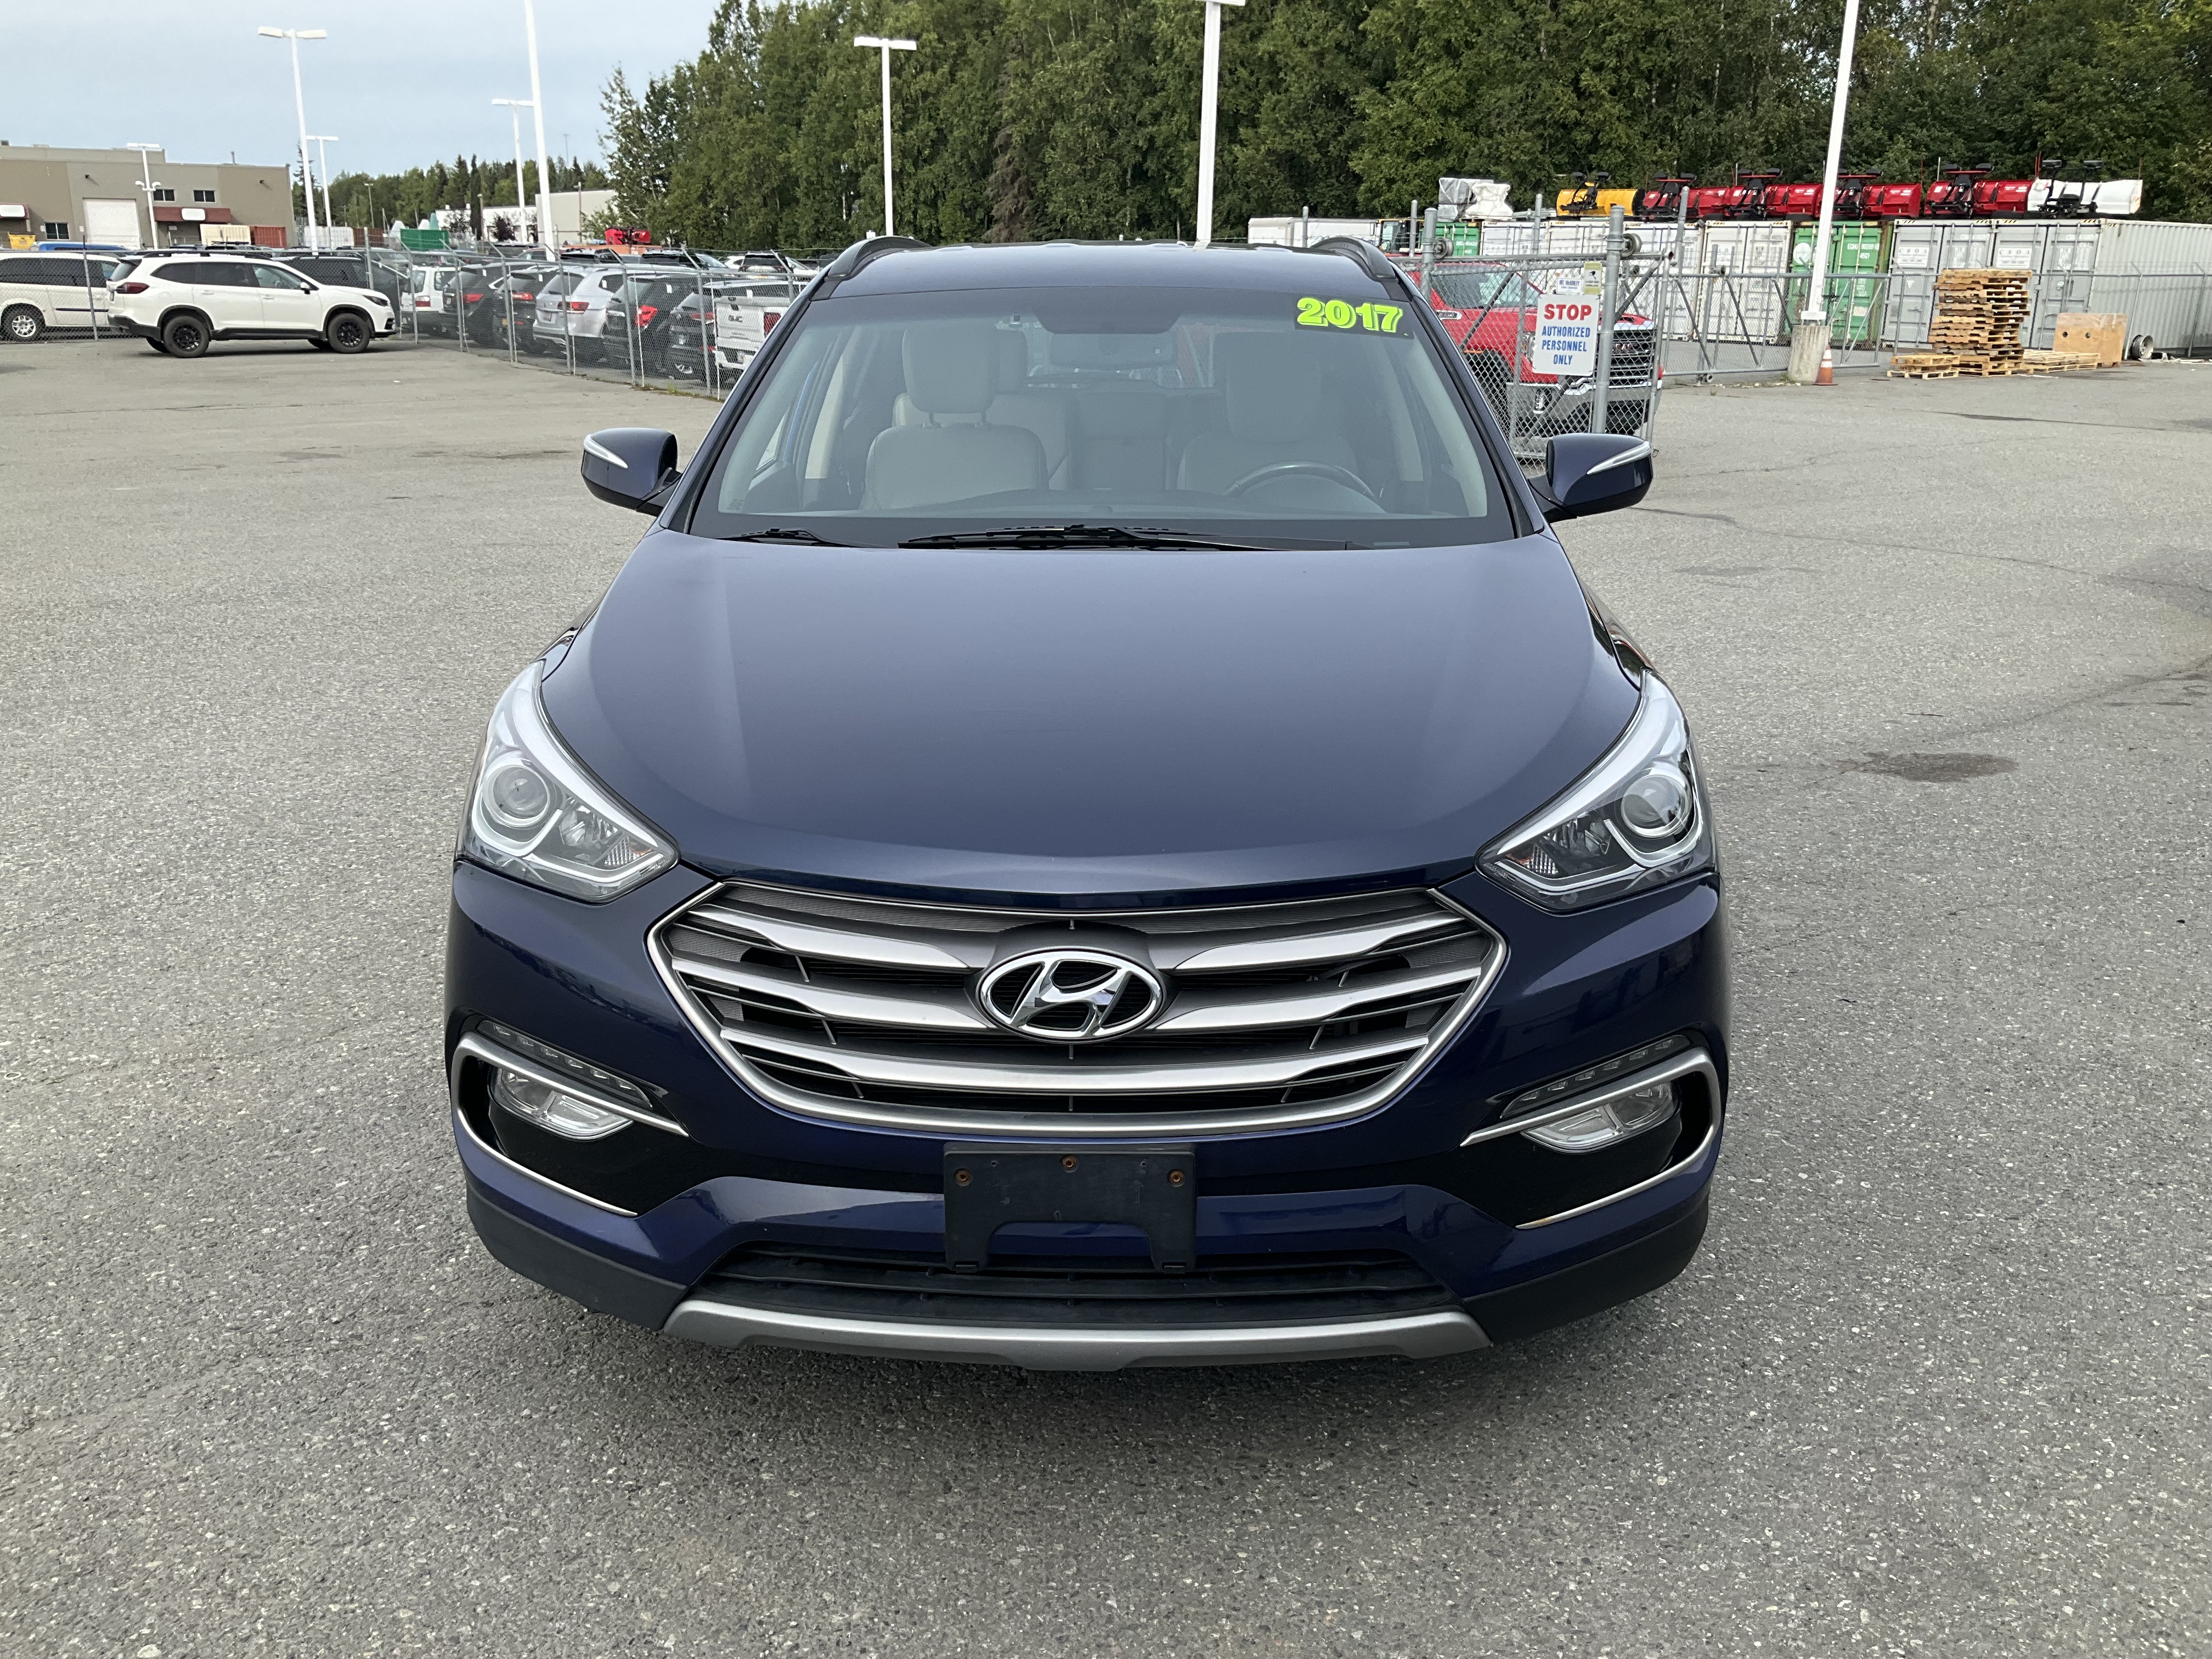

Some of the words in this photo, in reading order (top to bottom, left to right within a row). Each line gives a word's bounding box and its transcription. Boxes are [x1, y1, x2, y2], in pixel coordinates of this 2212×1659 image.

[1297, 296, 1403, 333] 2017
[1543, 303, 1592, 321] STOP
[1542, 326, 1590, 338] AUTHORIZED
[1542, 340, 1587, 352] PERSONNEL
[1553, 354, 1573, 365] ONLY
